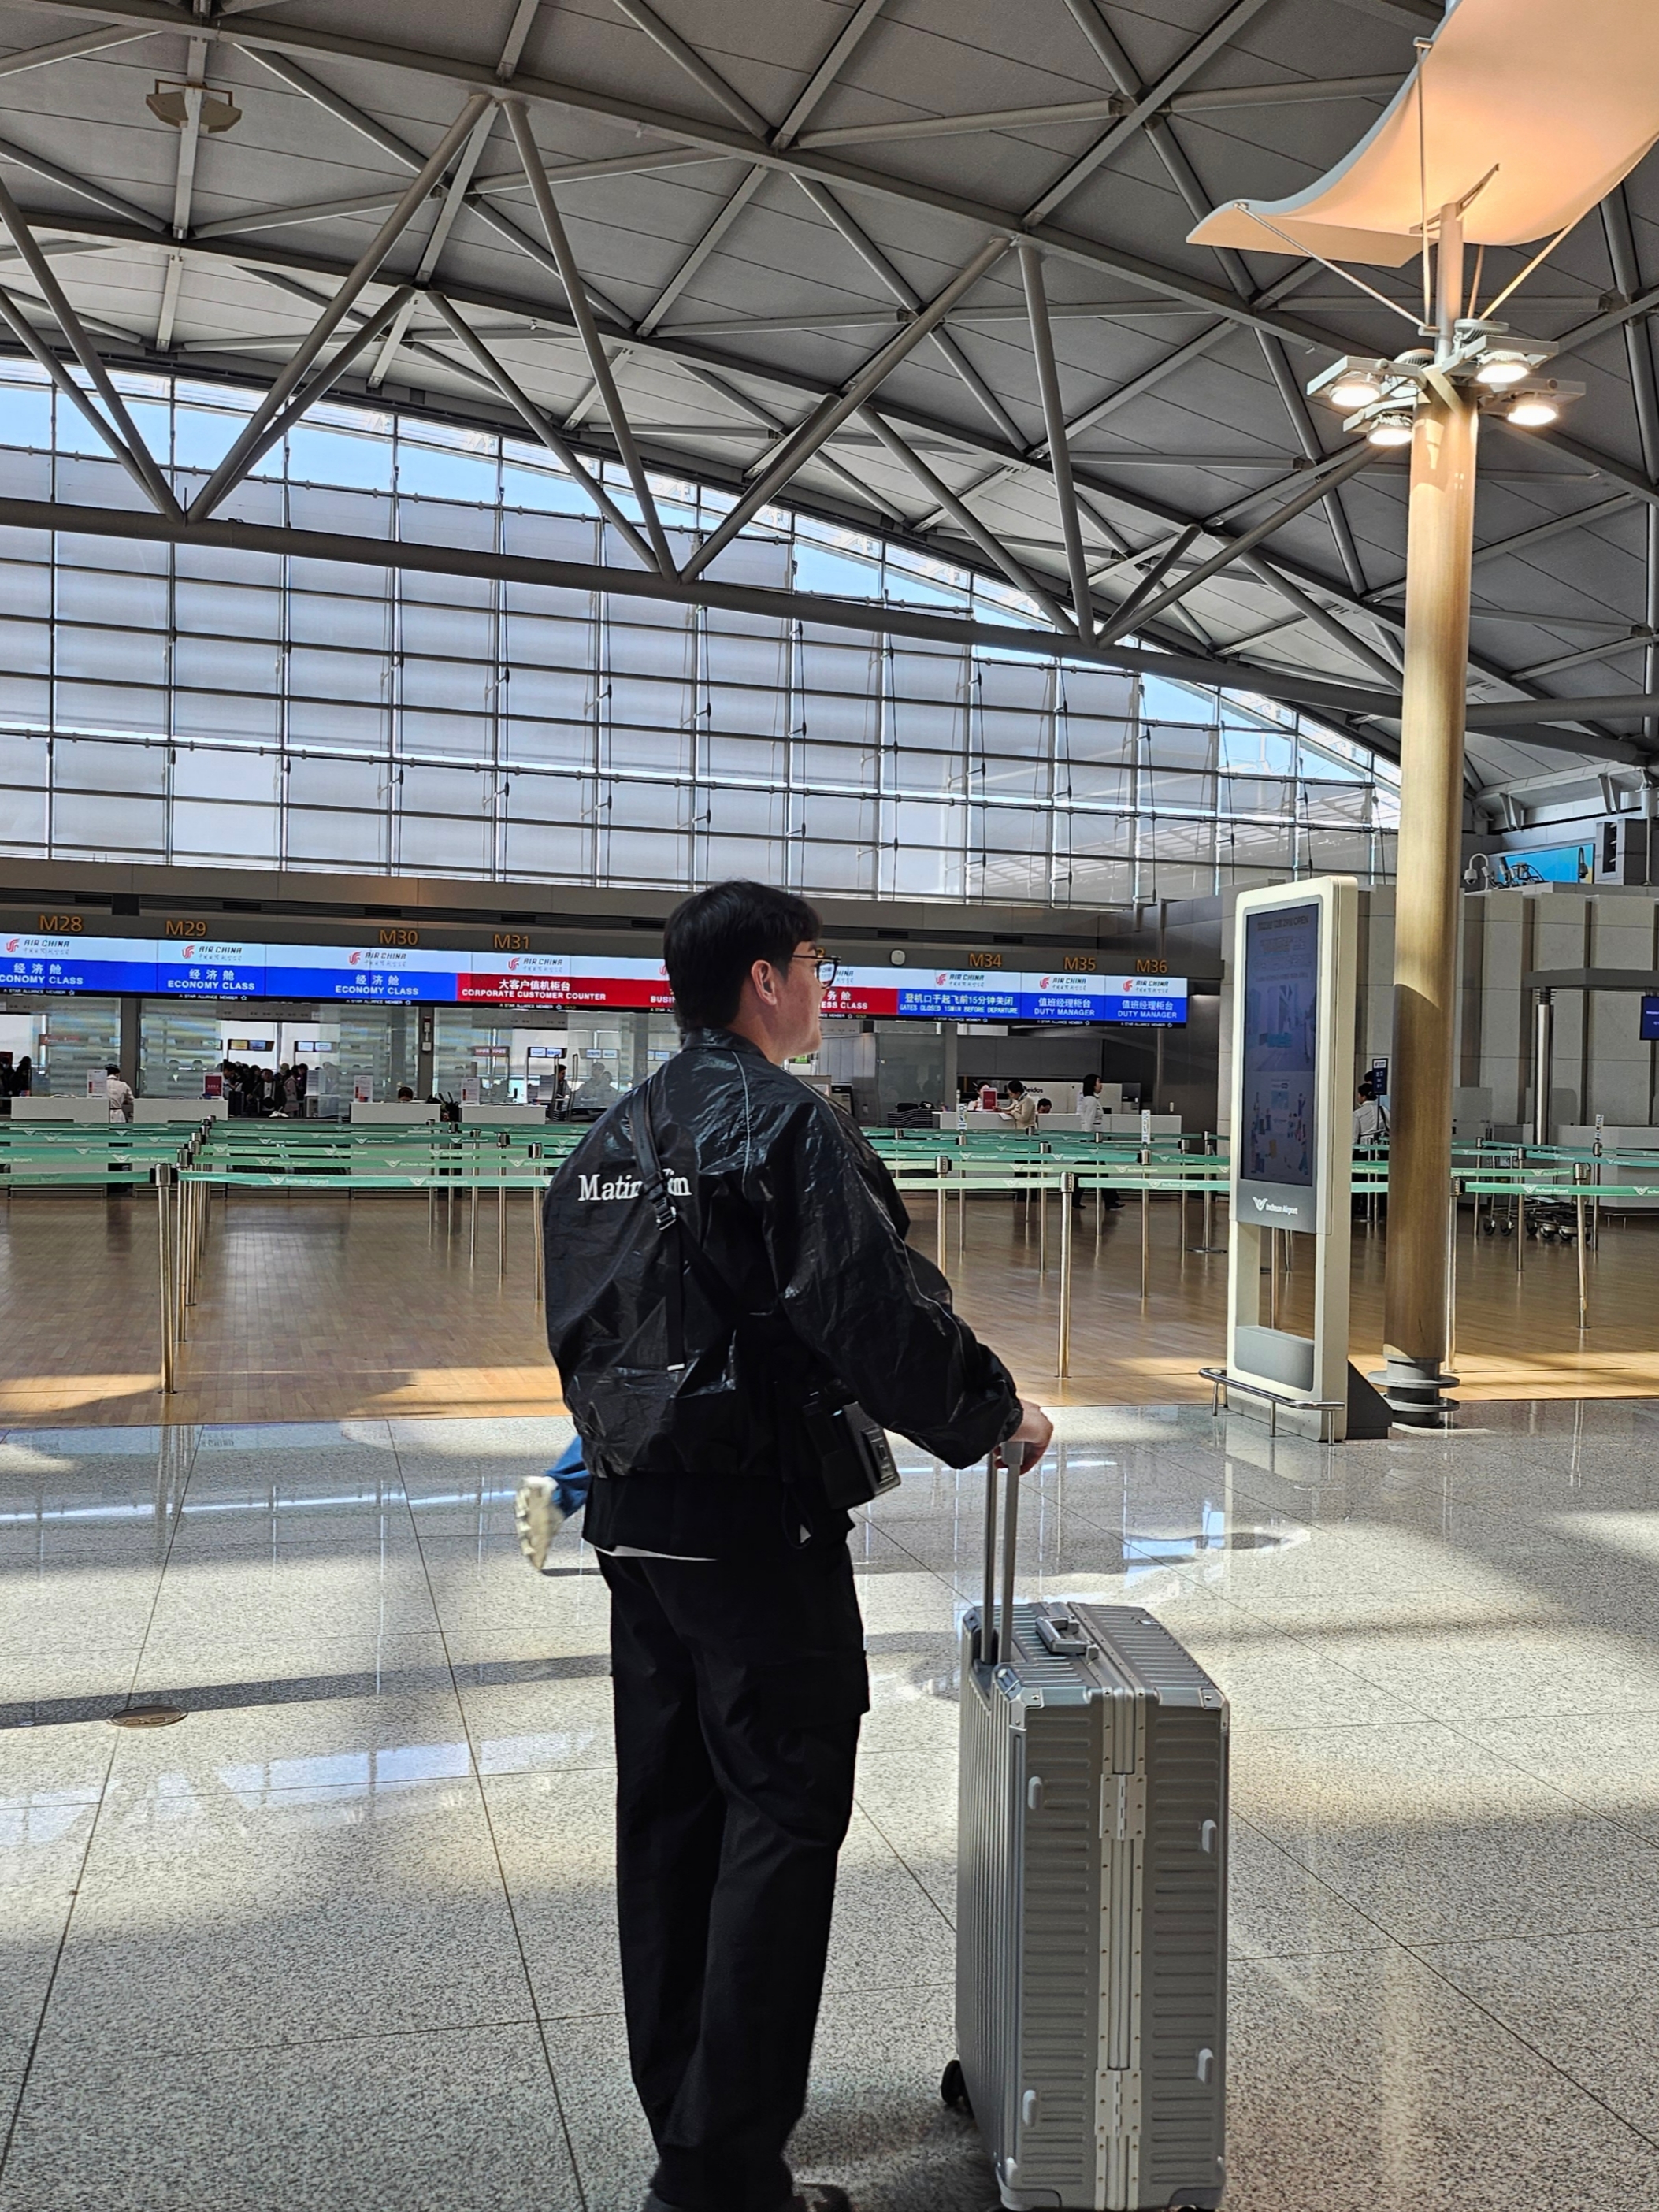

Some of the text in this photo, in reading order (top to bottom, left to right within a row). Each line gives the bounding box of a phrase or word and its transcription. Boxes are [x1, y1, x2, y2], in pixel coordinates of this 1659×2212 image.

[39, 915, 83, 931] M28
[165, 920, 206, 937] M29
[380, 930, 418, 945] M30
[494, 934, 529, 950] M31
[969, 953, 1002, 967] M34
[1064, 957, 1096, 971] M35
[14, 963, 61, 974] 经济舱
[1136, 959, 1167, 974] M36
[0, 974, 45, 984] CONOMY
[189, 969, 235, 981] 经济舱
[356, 974, 399, 986] 经济舱
[168, 980, 254, 991] ECONOMY CLASS
[336, 985, 384, 994] ECONOMY
[499, 979, 570, 992] 大客户值机柜台
[827, 991, 851, 1000] 务舱
[1266, 1203, 1298, 1215] Incheon Airport
